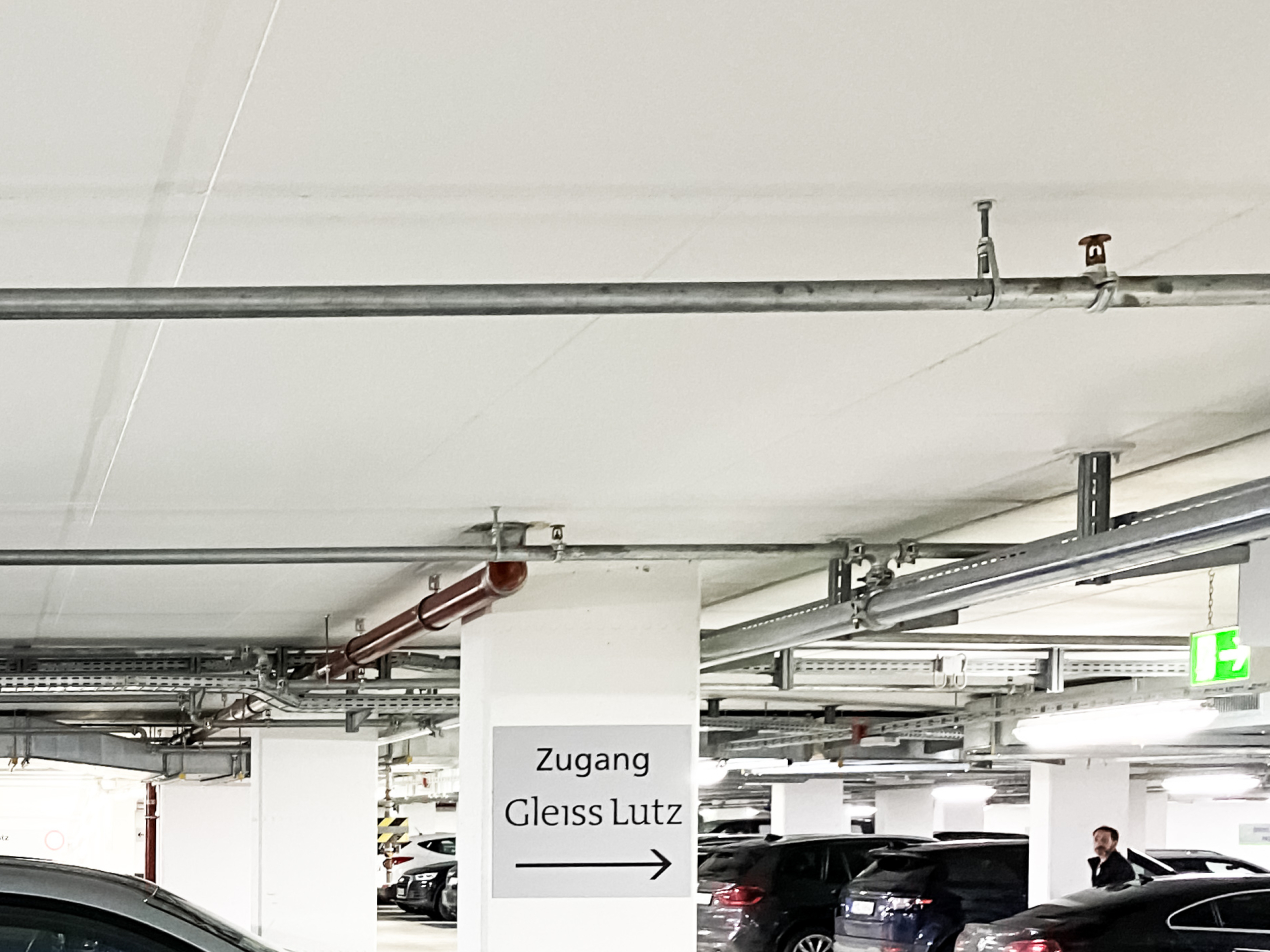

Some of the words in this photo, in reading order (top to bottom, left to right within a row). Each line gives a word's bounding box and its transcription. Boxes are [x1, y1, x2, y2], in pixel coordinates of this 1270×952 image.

[536, 747, 650, 778] Zugang
[505, 795, 603, 827] Gleiss
[610, 797, 683, 826] Lutz
